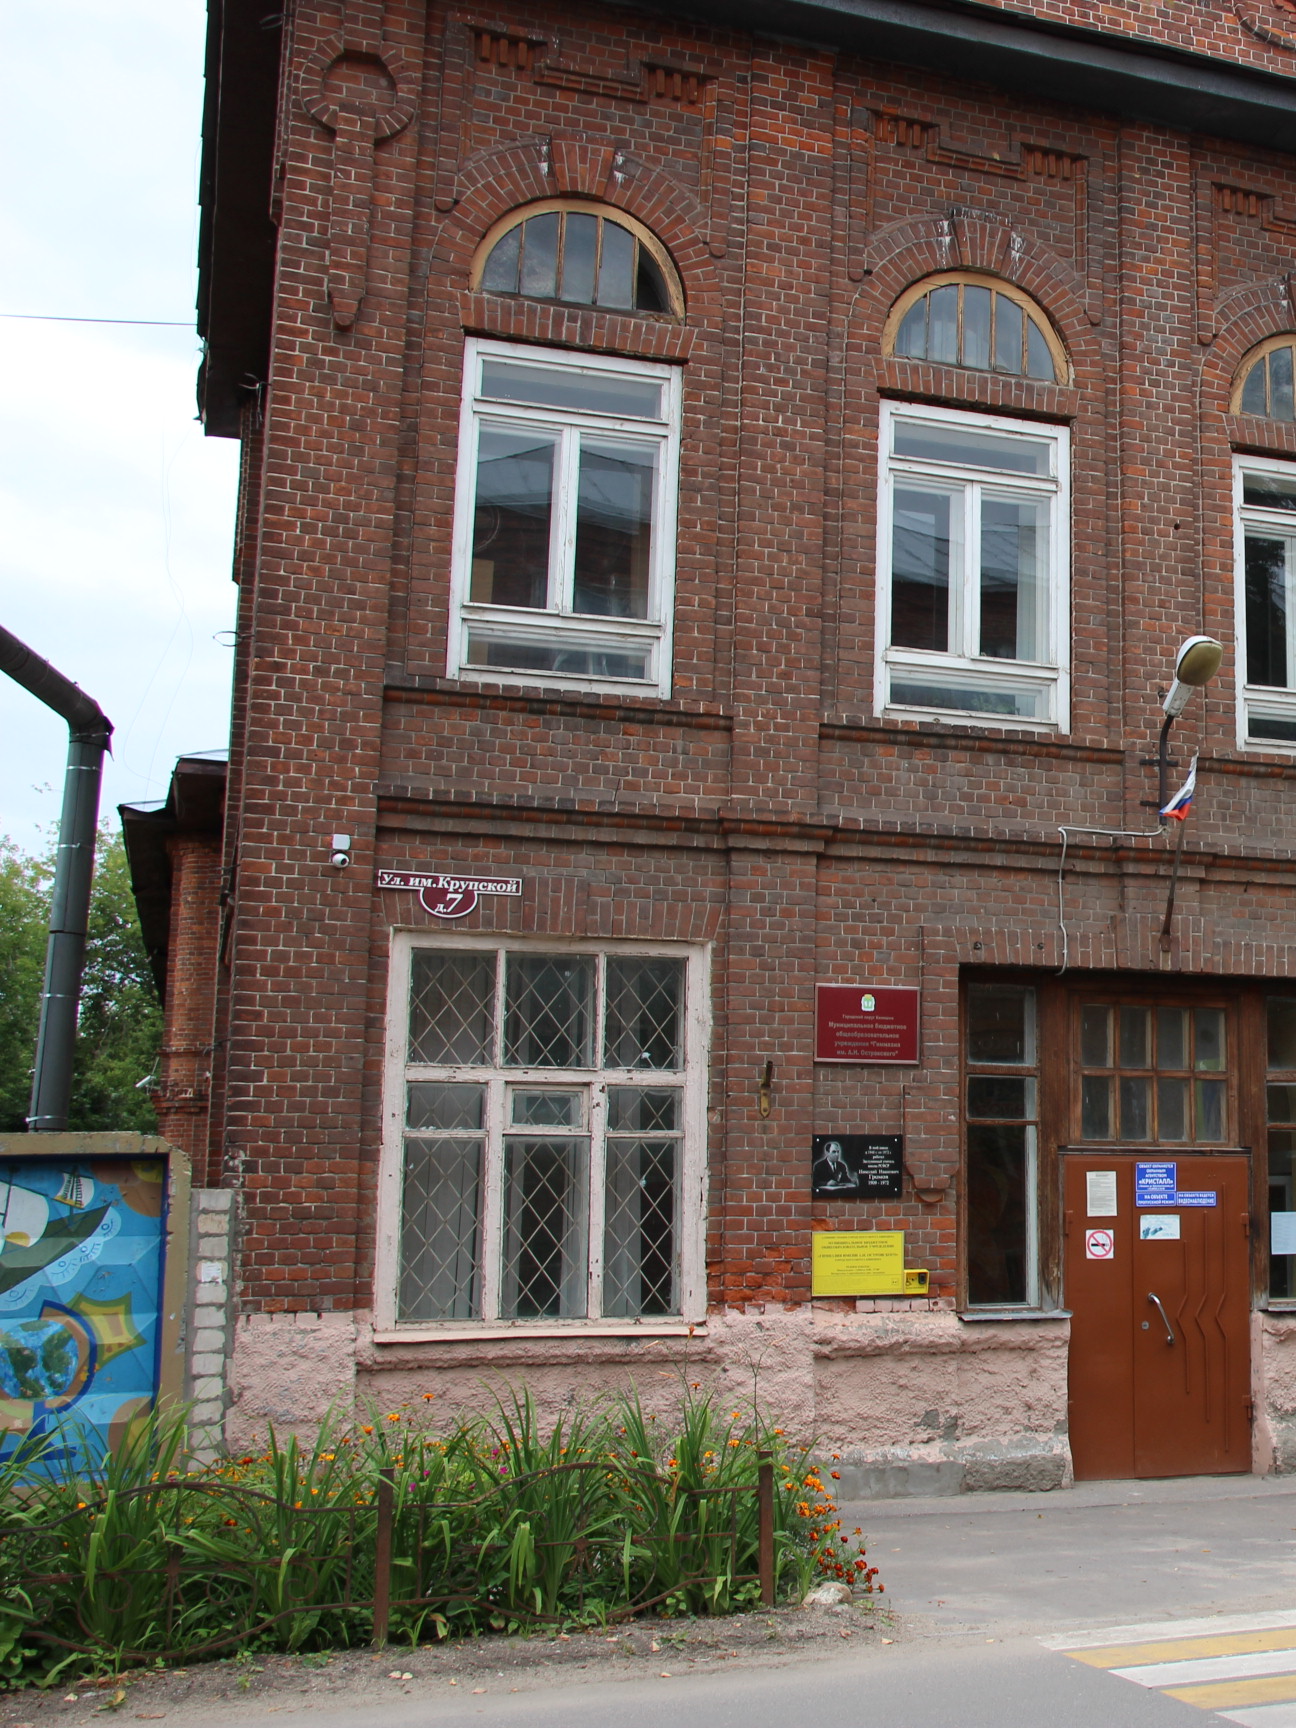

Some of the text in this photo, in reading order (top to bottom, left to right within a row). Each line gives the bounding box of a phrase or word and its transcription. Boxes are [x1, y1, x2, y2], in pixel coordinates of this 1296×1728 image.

[382, 874, 404, 886] Ул.
[828, 1021, 874, 1029] Муниципальное
[836, 1030, 899, 1038] общеобразовательное
